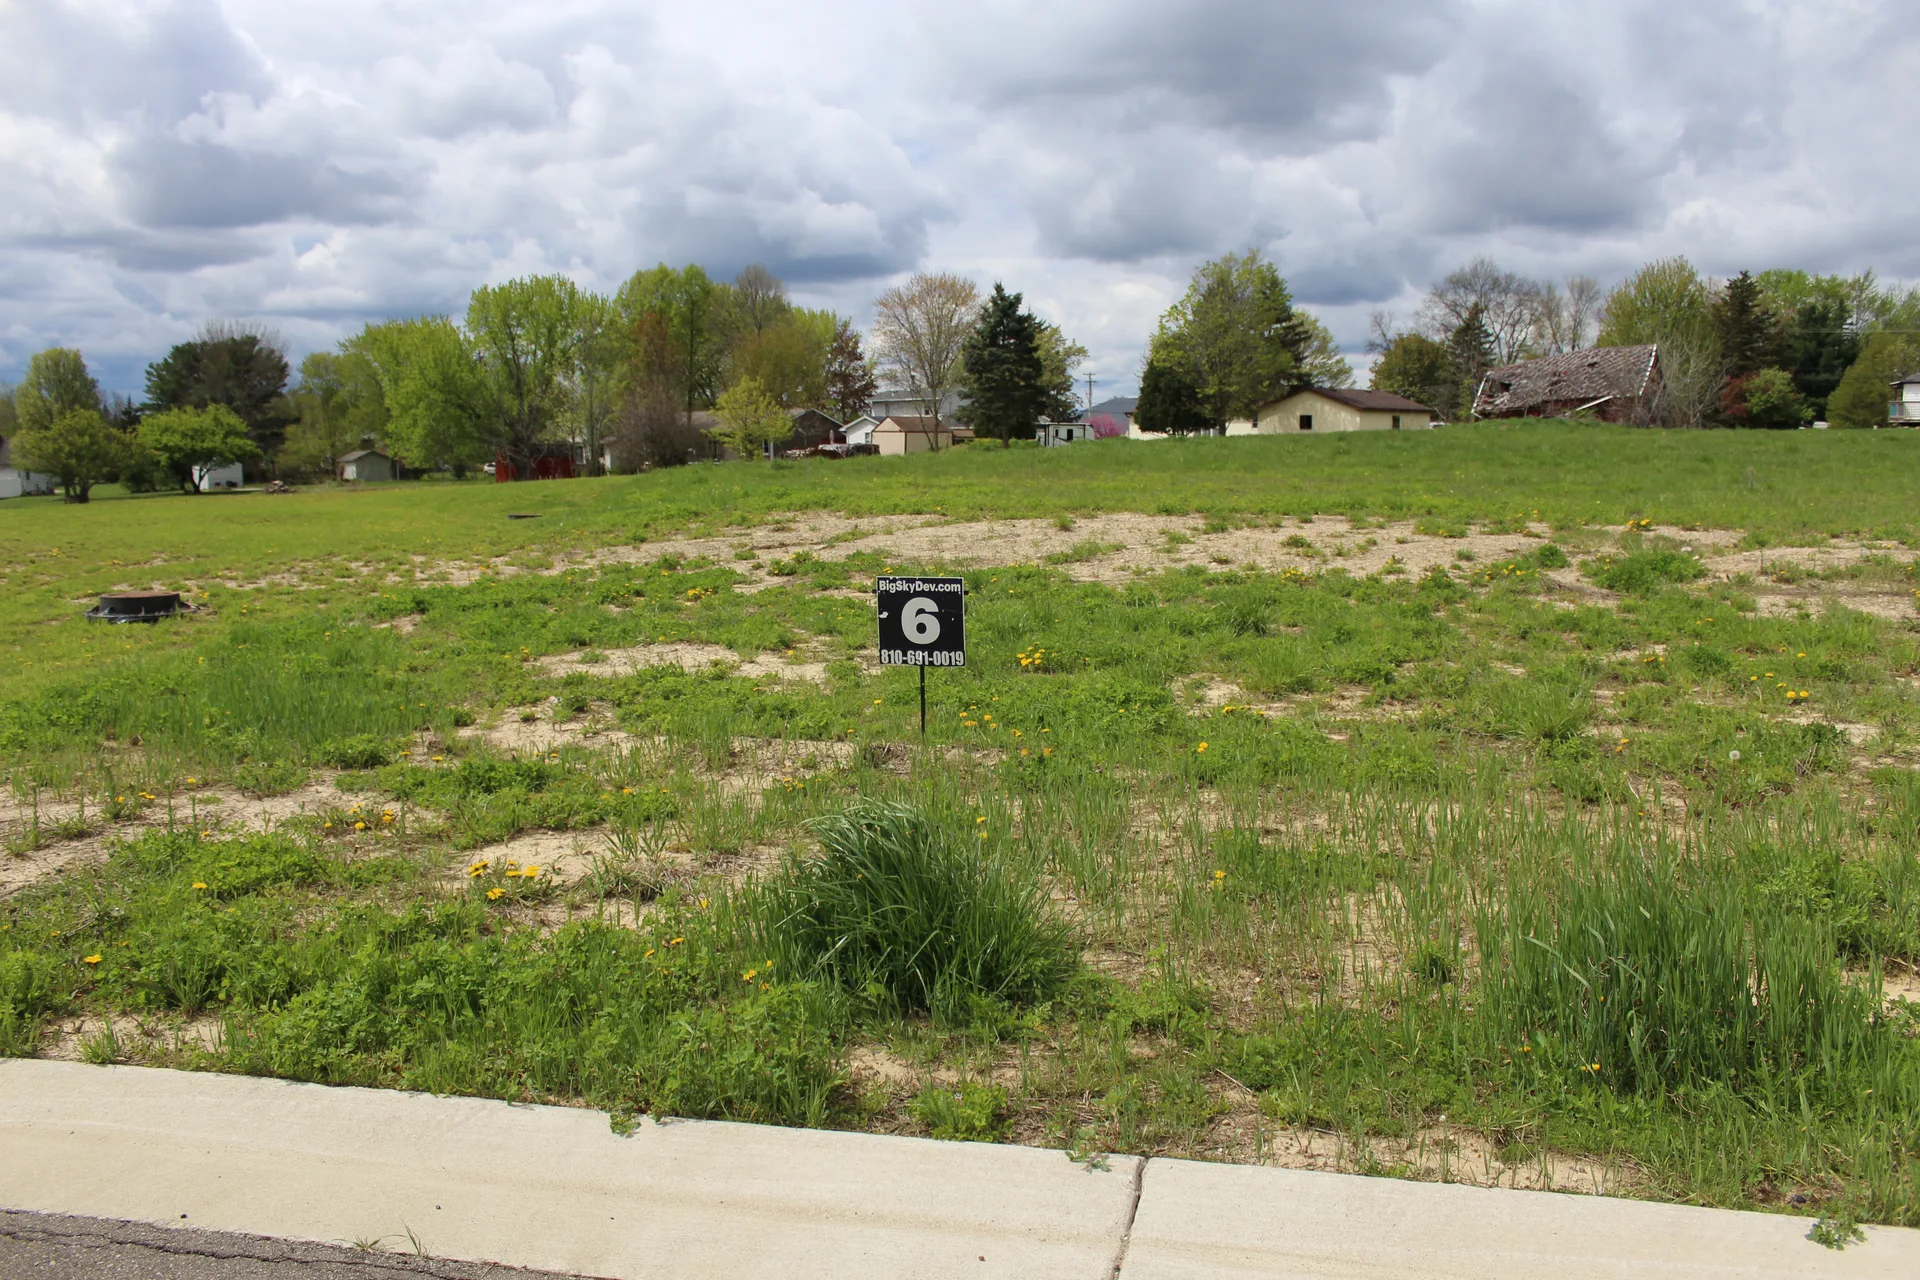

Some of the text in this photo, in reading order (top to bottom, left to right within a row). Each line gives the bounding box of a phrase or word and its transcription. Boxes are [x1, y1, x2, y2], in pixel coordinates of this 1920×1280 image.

[879, 580, 961, 593] BigSkyDev.com
[901, 597, 941, 645] 6
[880, 649, 964, 666] 810-691-0019
